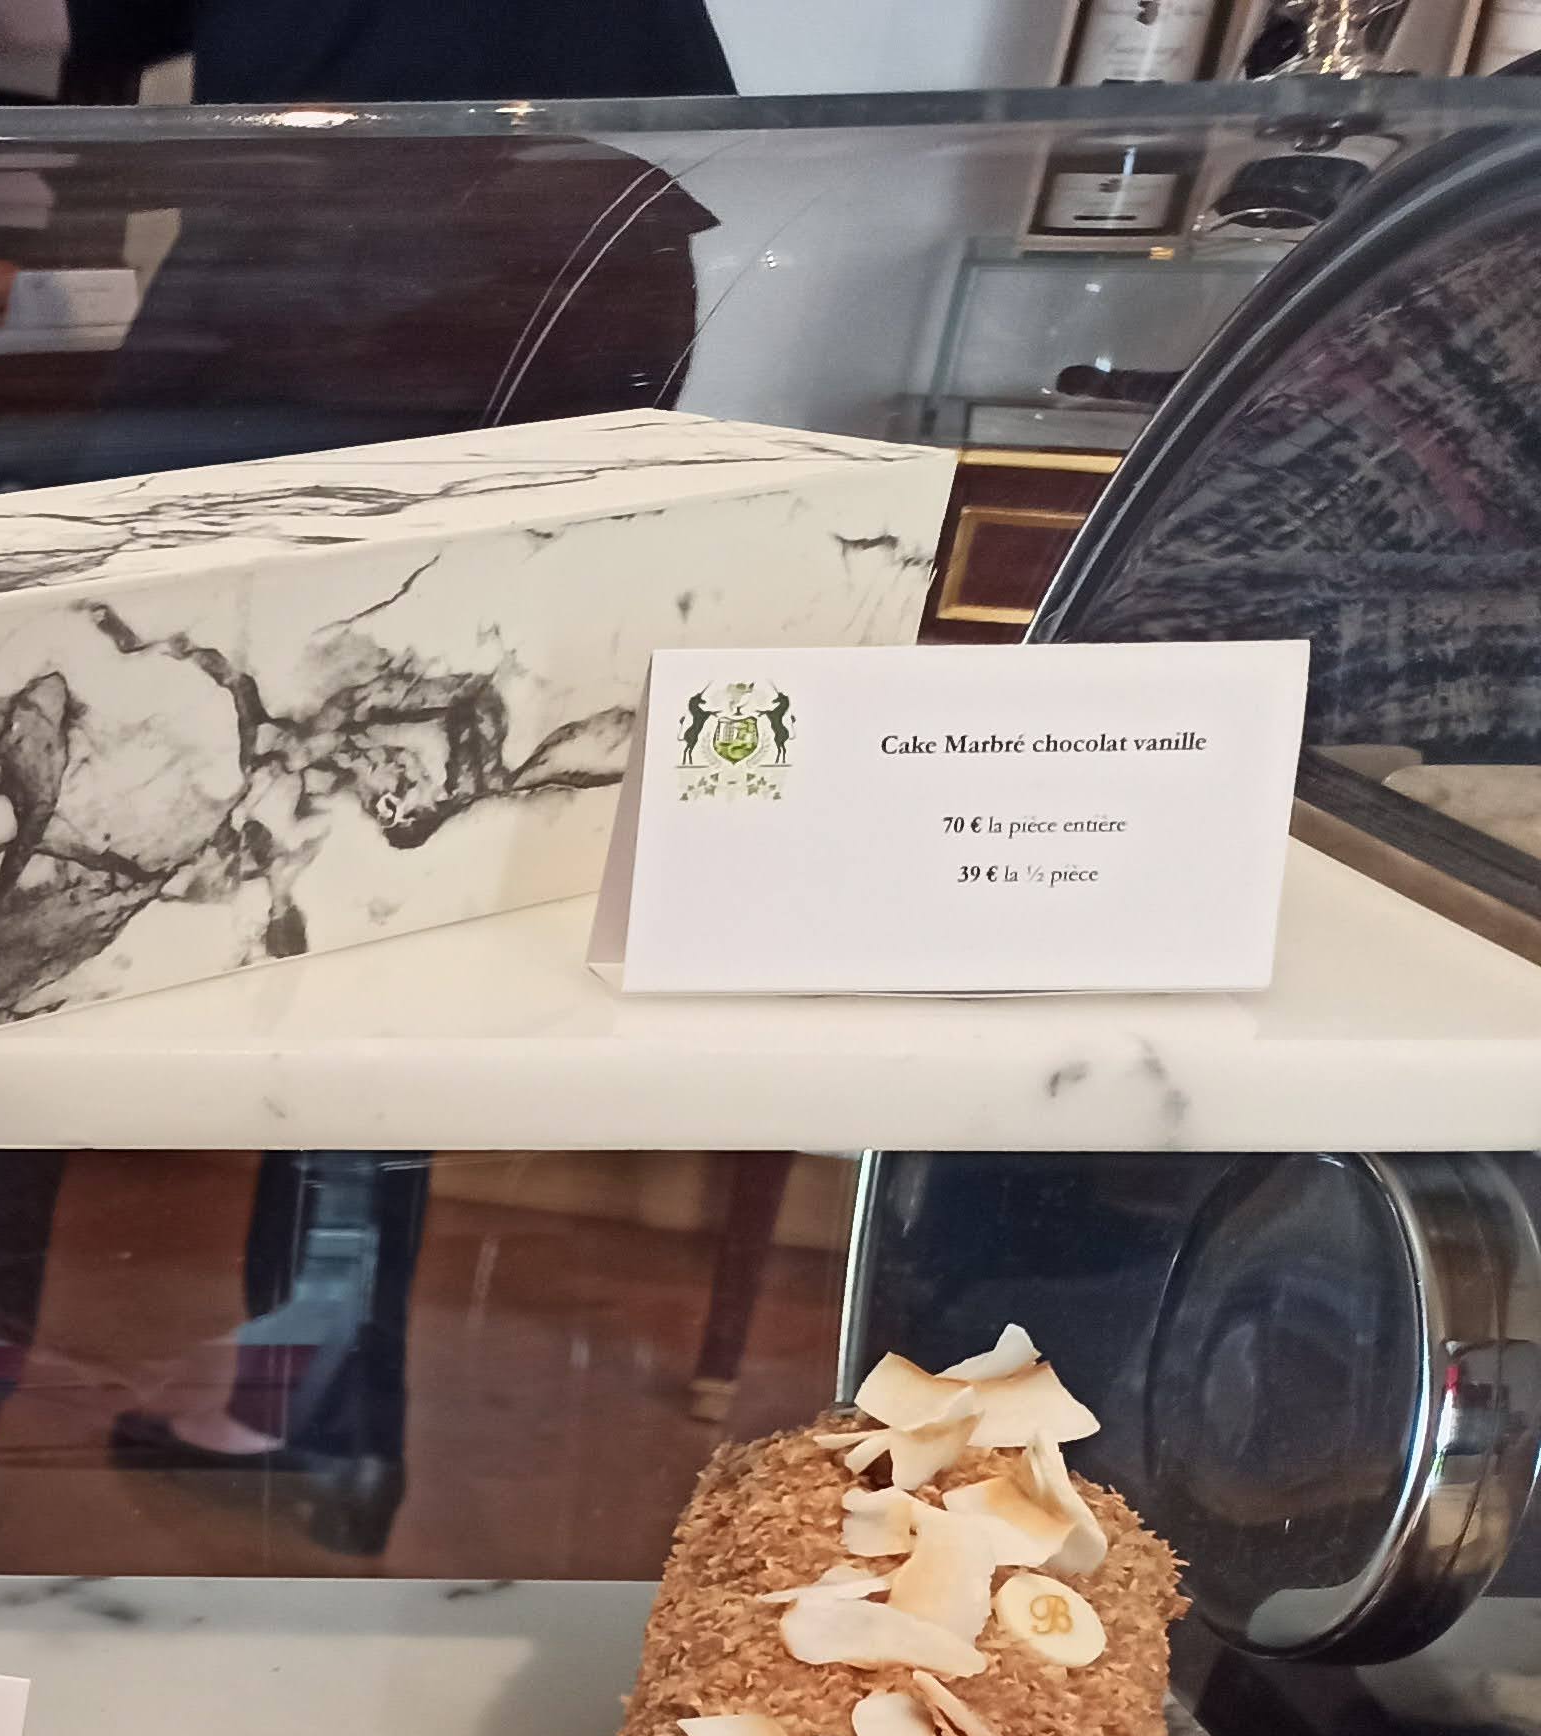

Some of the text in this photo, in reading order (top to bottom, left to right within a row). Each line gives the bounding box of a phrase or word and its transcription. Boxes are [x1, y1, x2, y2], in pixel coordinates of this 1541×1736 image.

[881, 731, 1207, 755] Cake Marbré chocolat vanille
[942, 814, 1128, 839] 70 € la pièce entière
[957, 865, 981, 883] 39
[986, 865, 998, 882] €
[1004, 865, 1018, 882] la
[1050, 864, 1099, 887] pièce
